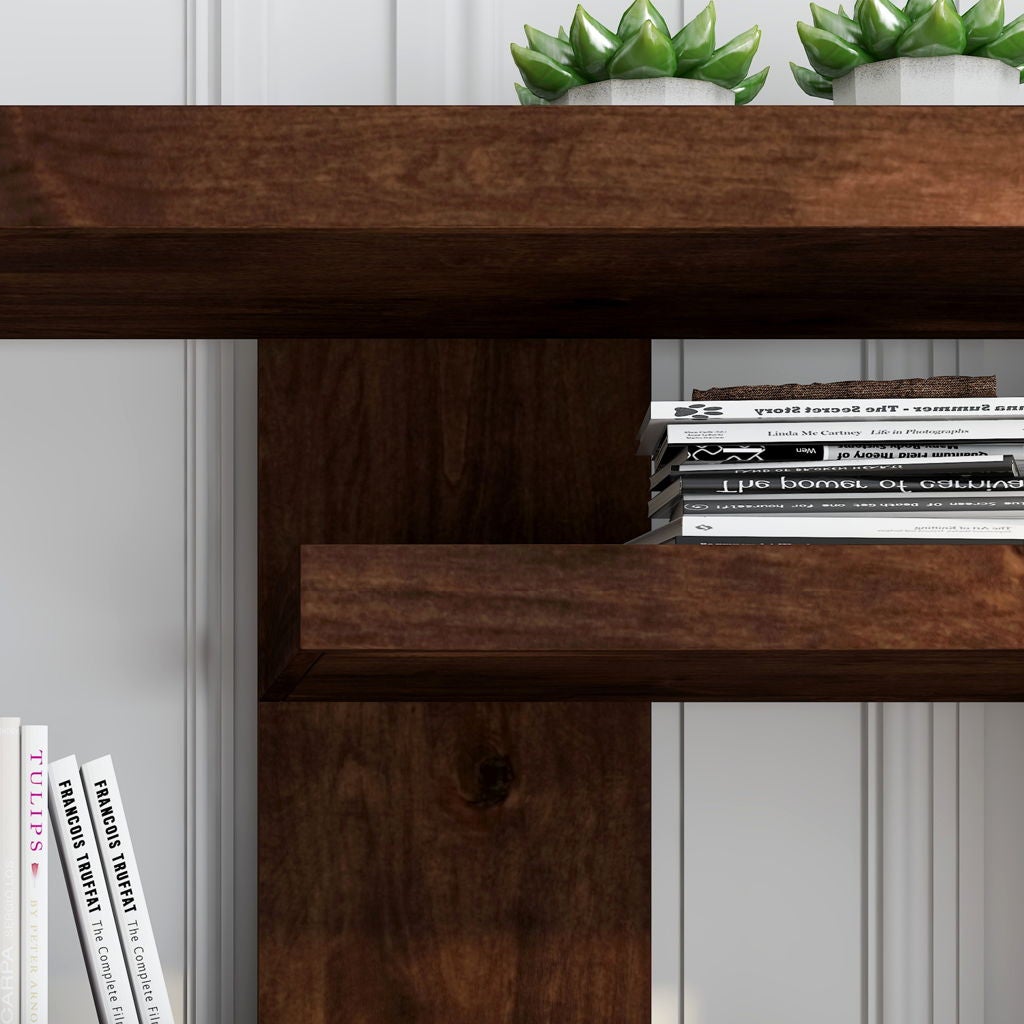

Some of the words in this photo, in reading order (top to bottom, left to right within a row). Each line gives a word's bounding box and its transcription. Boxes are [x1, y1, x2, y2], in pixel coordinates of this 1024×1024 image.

[854, 451, 894, 460] Theory
[30, 750, 43, 852] TULIPS
[59, 780, 86, 849] FRANCOIS
[94, 780, 121, 849] FRANCOIS
[30, 900, 38, 920] BY
[76, 852, 100, 914] TRUFFAT
[112, 852, 136, 913] TRUFFAT
[92, 920, 104, 942] The
[127, 920, 139, 942] The
[96, 947, 118, 1002] Complete
[132, 947, 153, 1002] Complete
